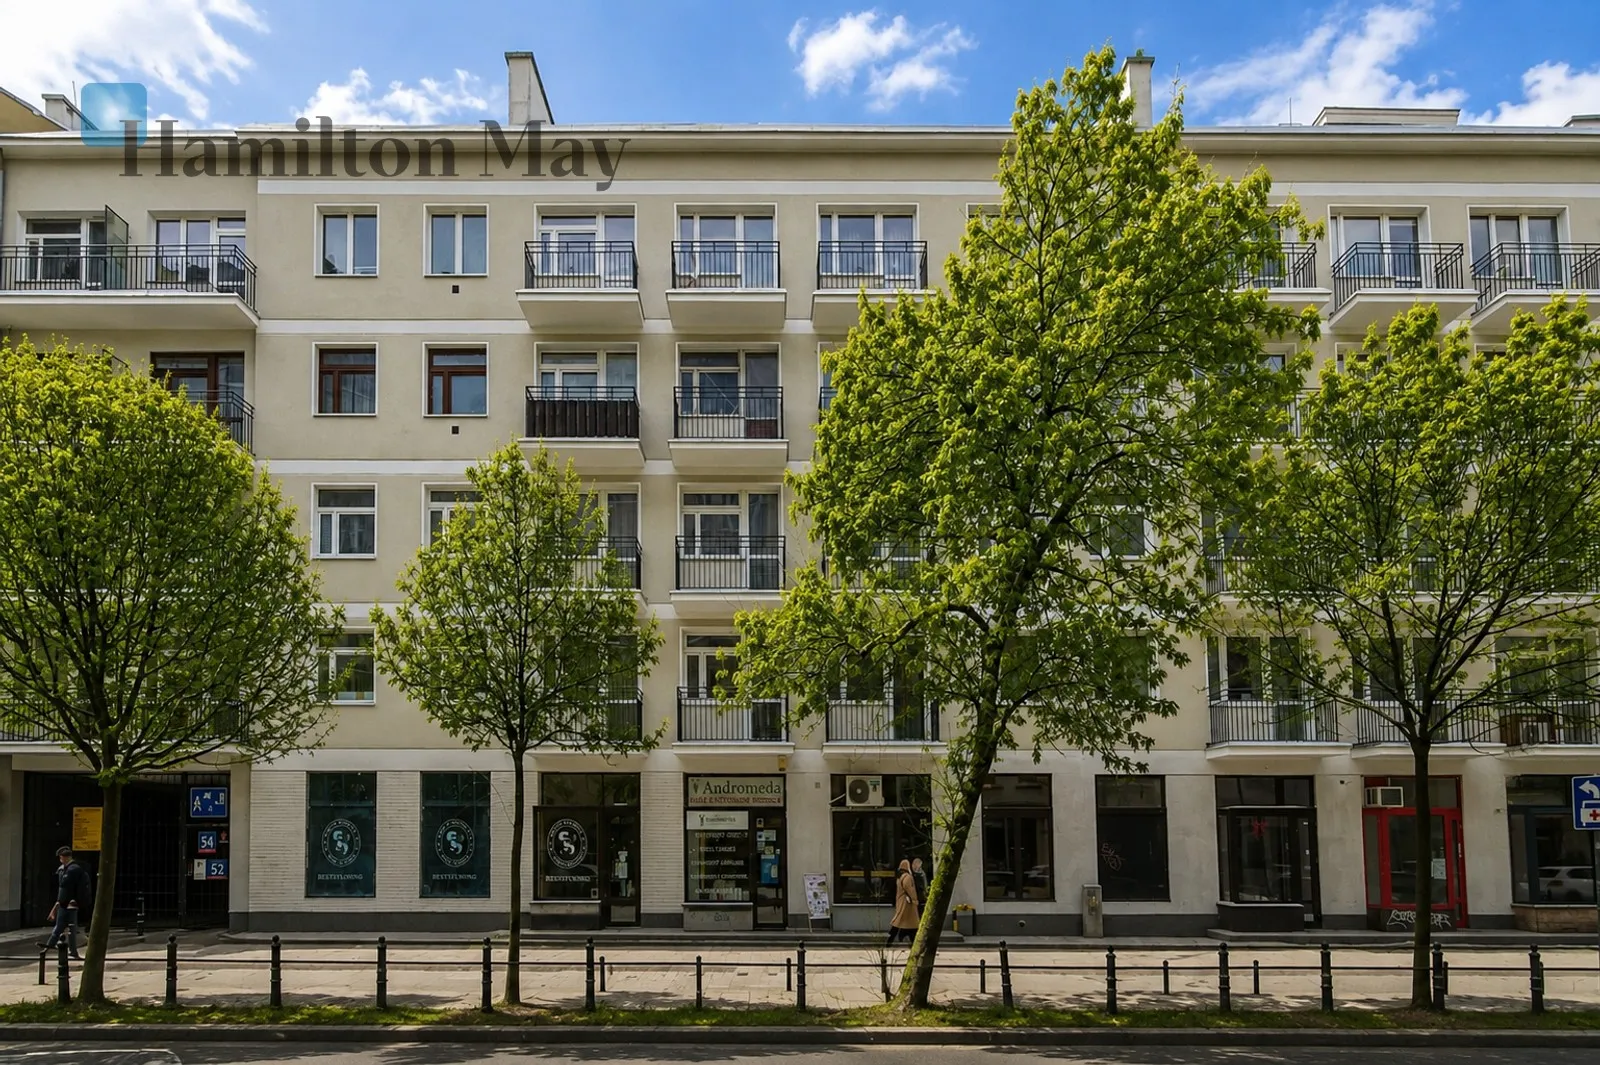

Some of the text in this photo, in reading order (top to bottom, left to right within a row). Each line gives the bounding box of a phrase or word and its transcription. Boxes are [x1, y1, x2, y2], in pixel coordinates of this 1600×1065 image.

[703, 780, 781, 794] Andromeda
[201, 835, 213, 848] 54
[211, 863, 224, 875] 52
